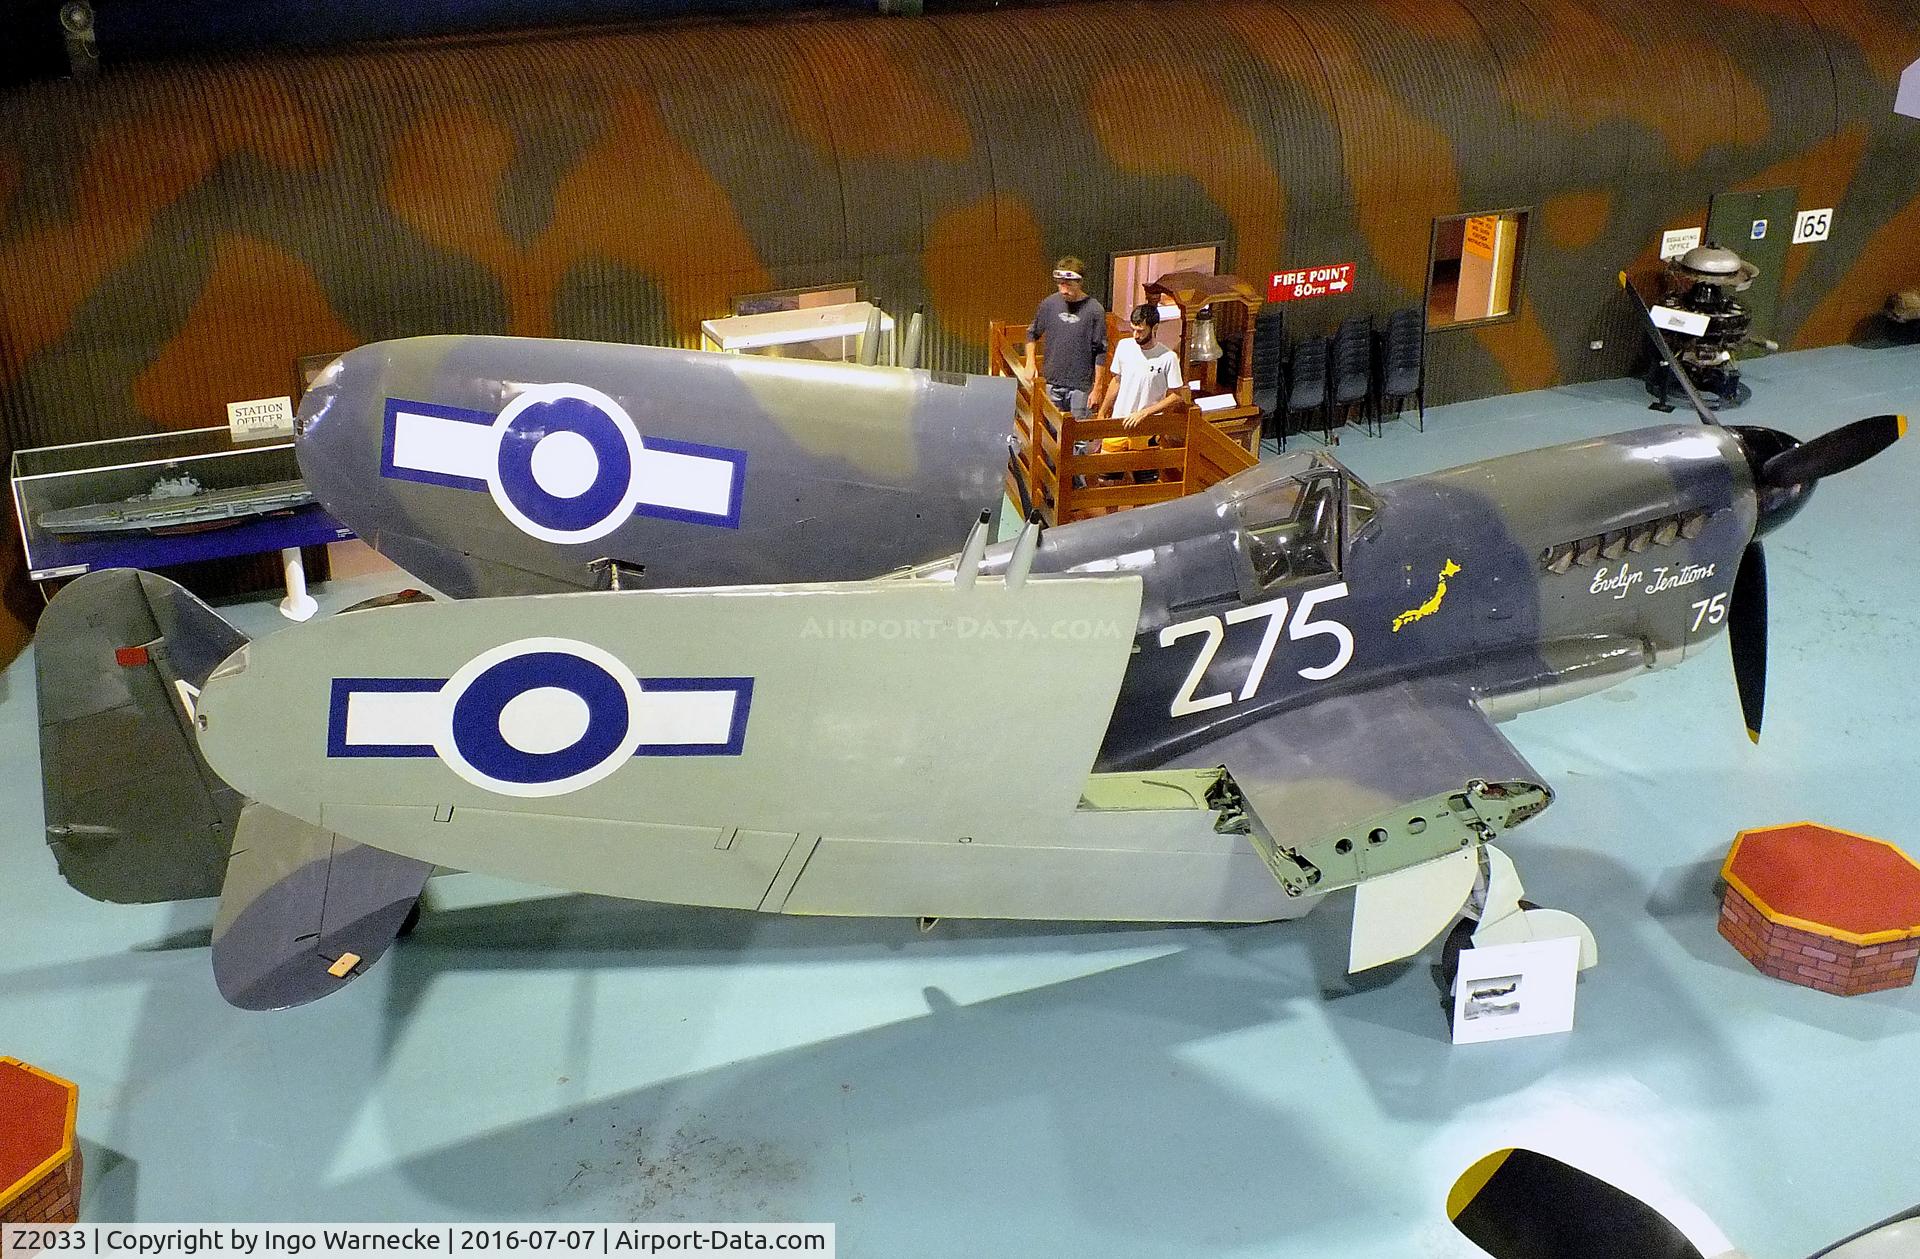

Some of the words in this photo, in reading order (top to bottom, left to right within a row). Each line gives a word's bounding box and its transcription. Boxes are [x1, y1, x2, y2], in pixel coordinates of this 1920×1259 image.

[1798, 214, 1828, 238] 165
[1273, 272, 1306, 287] FIRE
[1309, 266, 1350, 282] POINT
[235, 402, 283, 417] STATION
[237, 413, 283, 425] OFFICER
[1589, 563, 1643, 600] Evelyn
[1691, 591, 1728, 632] 75
[1159, 582, 1354, 717] 275
